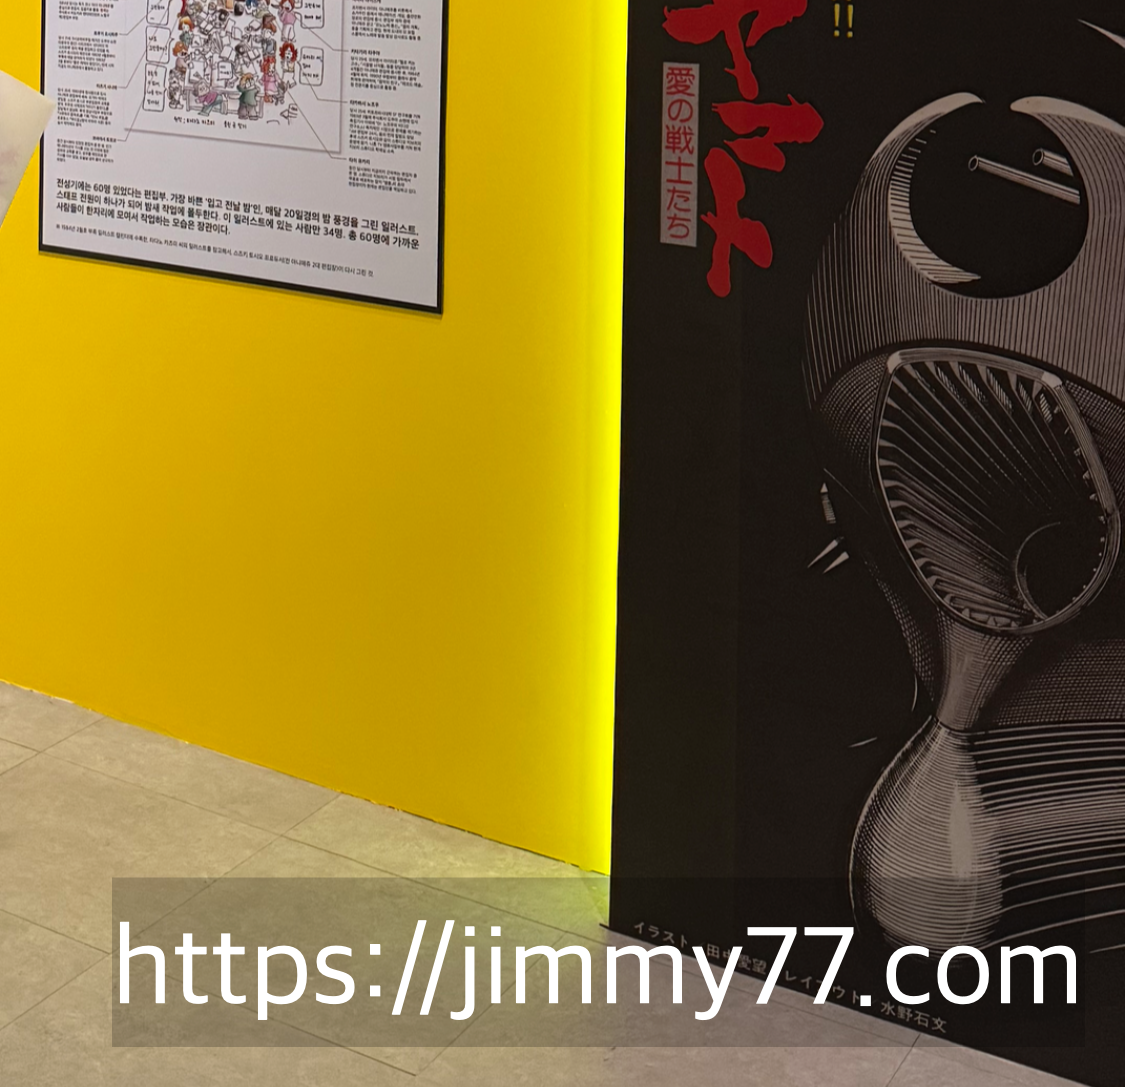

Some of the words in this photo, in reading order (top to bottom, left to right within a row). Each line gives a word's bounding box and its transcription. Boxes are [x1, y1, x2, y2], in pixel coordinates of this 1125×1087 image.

[664, 66, 697, 241] 愛の戦士たち
